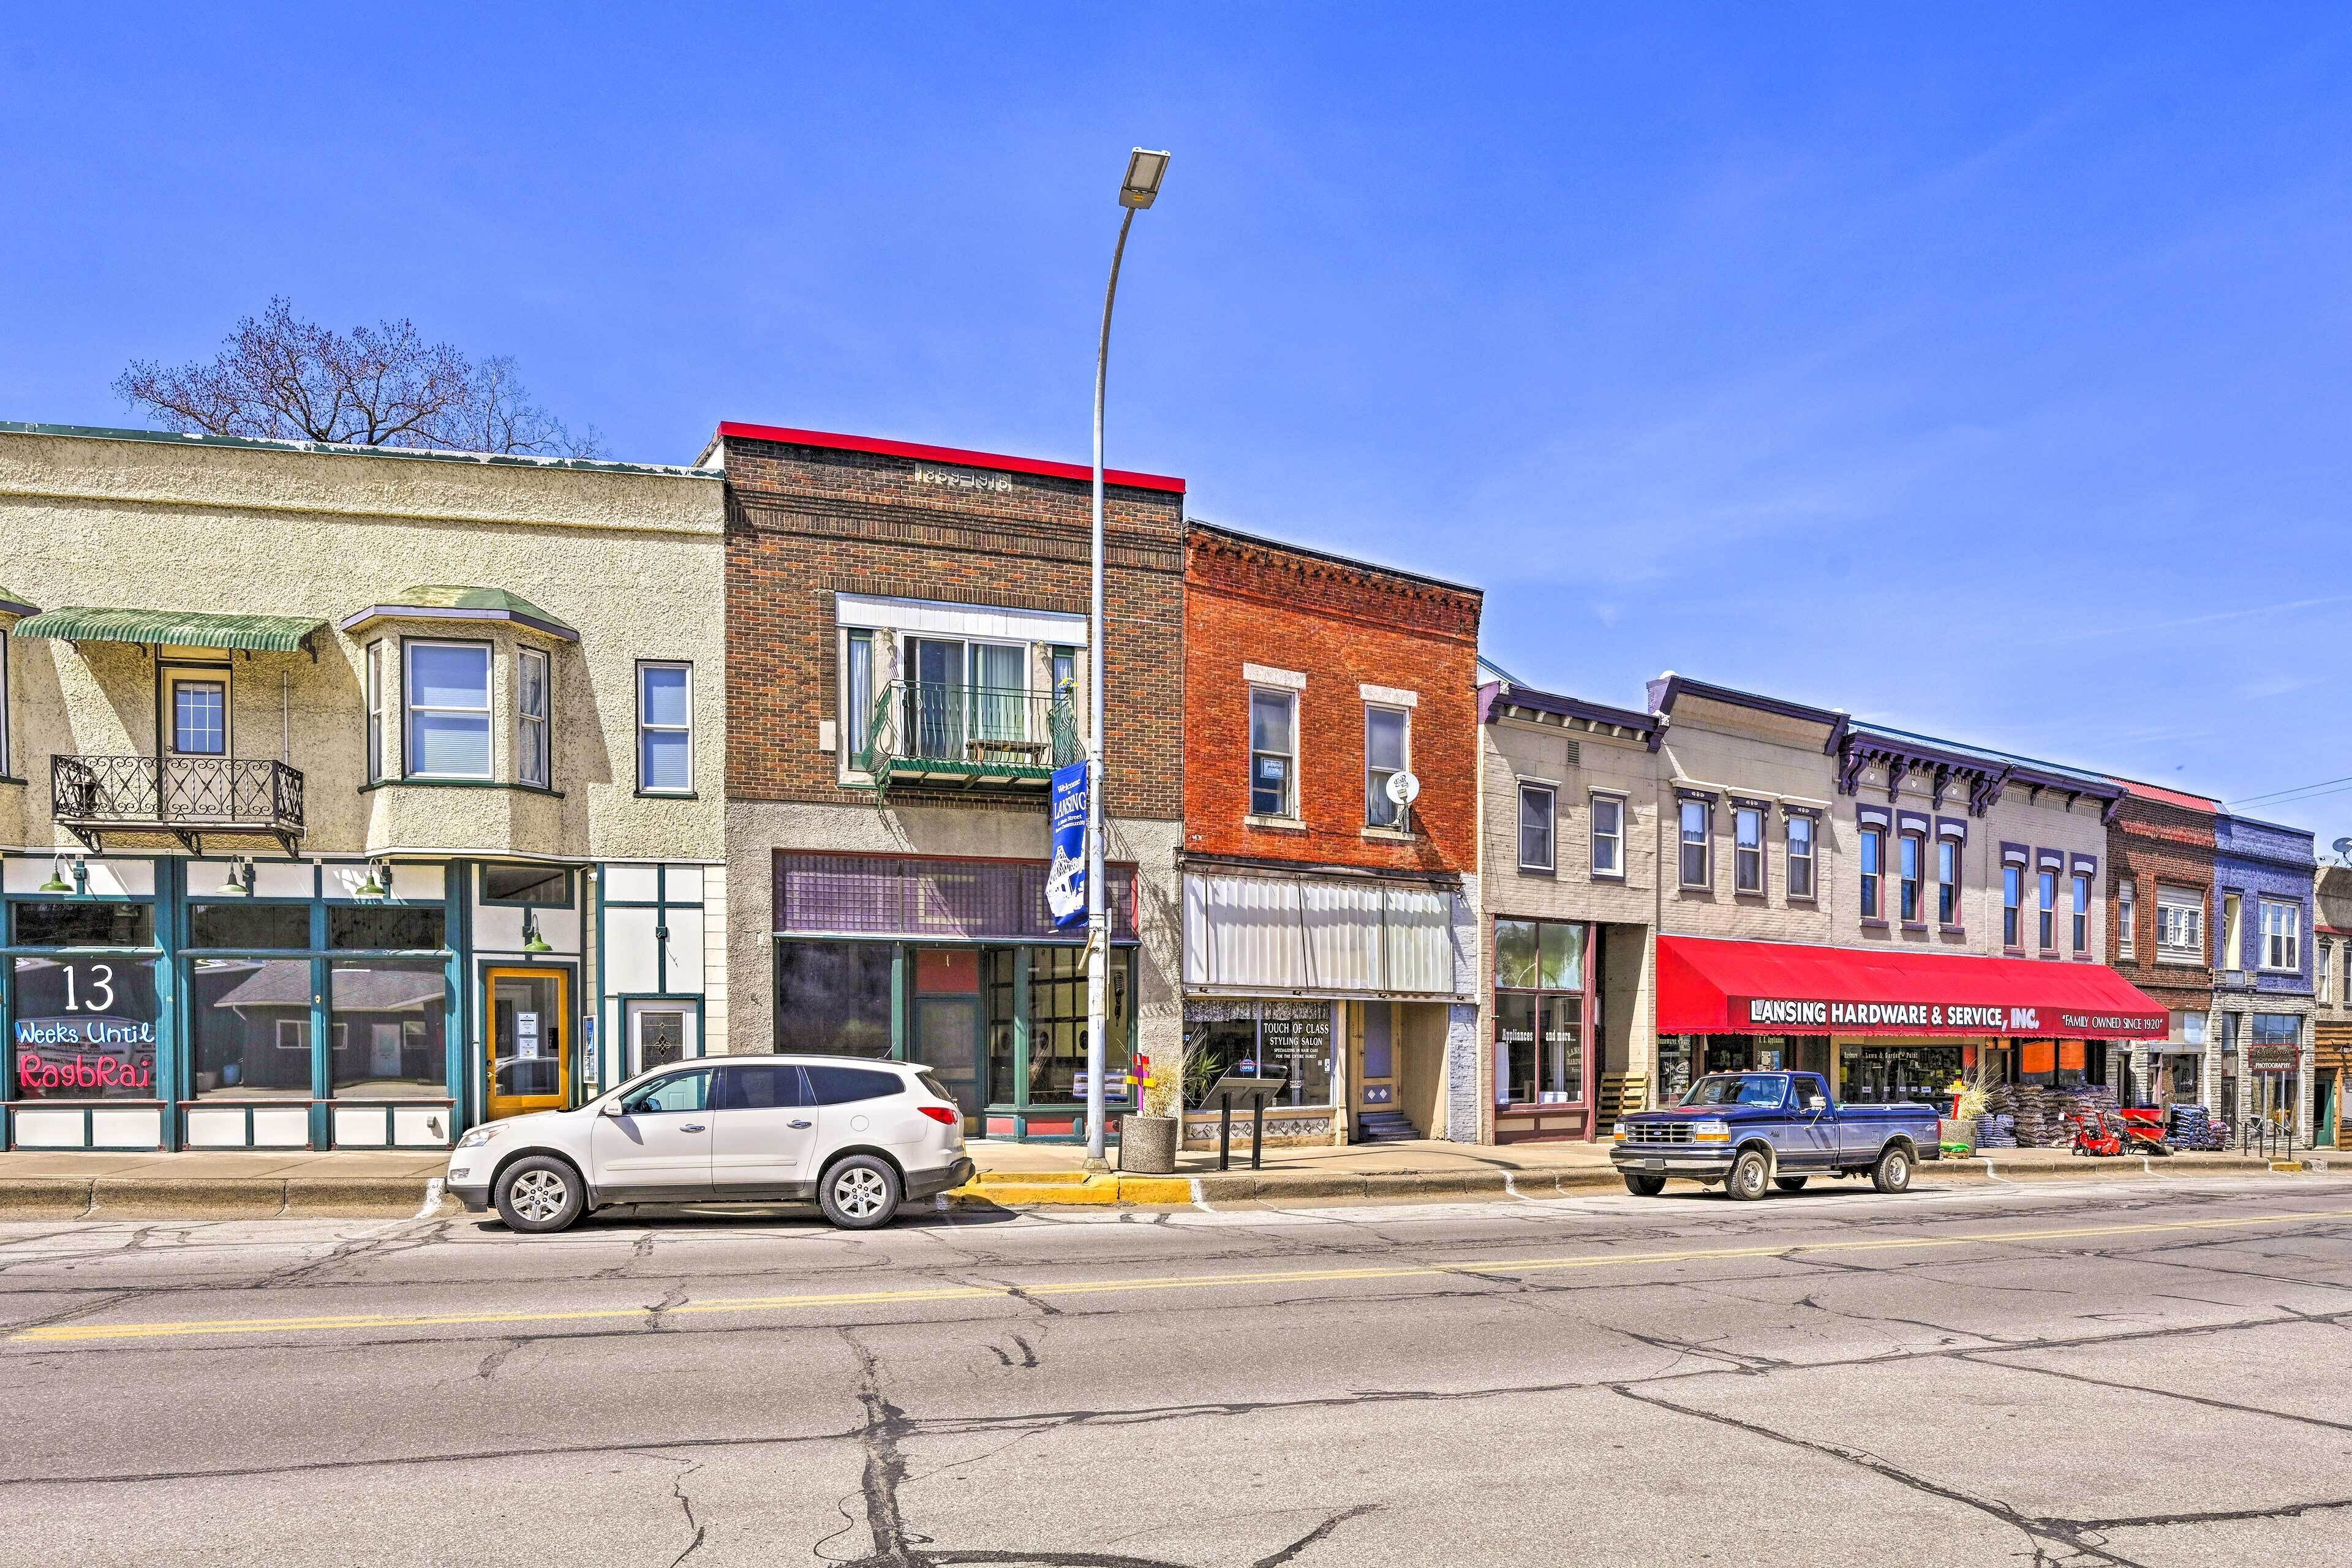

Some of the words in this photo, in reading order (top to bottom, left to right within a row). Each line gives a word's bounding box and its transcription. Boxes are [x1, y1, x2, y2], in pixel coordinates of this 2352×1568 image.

[919, 466, 1008, 489] 1859-1916
[1057, 778, 1080, 793] Welcome
[1054, 792, 1086, 820] LANSING
[62, 964, 114, 1011] 13
[1751, 1000, 1826, 1025] LANSING
[1831, 1003, 1928, 1025] HARDWARE
[1931, 1006, 1943, 1025] &
[1947, 1006, 2008, 1031] SERVICE,
[2011, 1008, 2040, 1030] INC.
[2092, 1016, 2121, 1028] OWNED
[2123, 1017, 2142, 1030] SINCE
[15, 1022, 79, 1044] Weeks
[86, 1022, 156, 1043] Until
[1264, 1023, 1289, 1033] TOUCH
[1293, 1023, 1303, 1034] OF
[1306, 1023, 1329, 1034] CLASS
[1502, 1028, 1533, 1043] Appliances
[1545, 1030, 1556, 1041] and
[1557, 1031, 1576, 1042] more...
[1270, 1037, 1298, 1046] STYLING
[1301, 1037, 1322, 1046] SALON
[2256, 1047, 2293, 1055] Riverside
